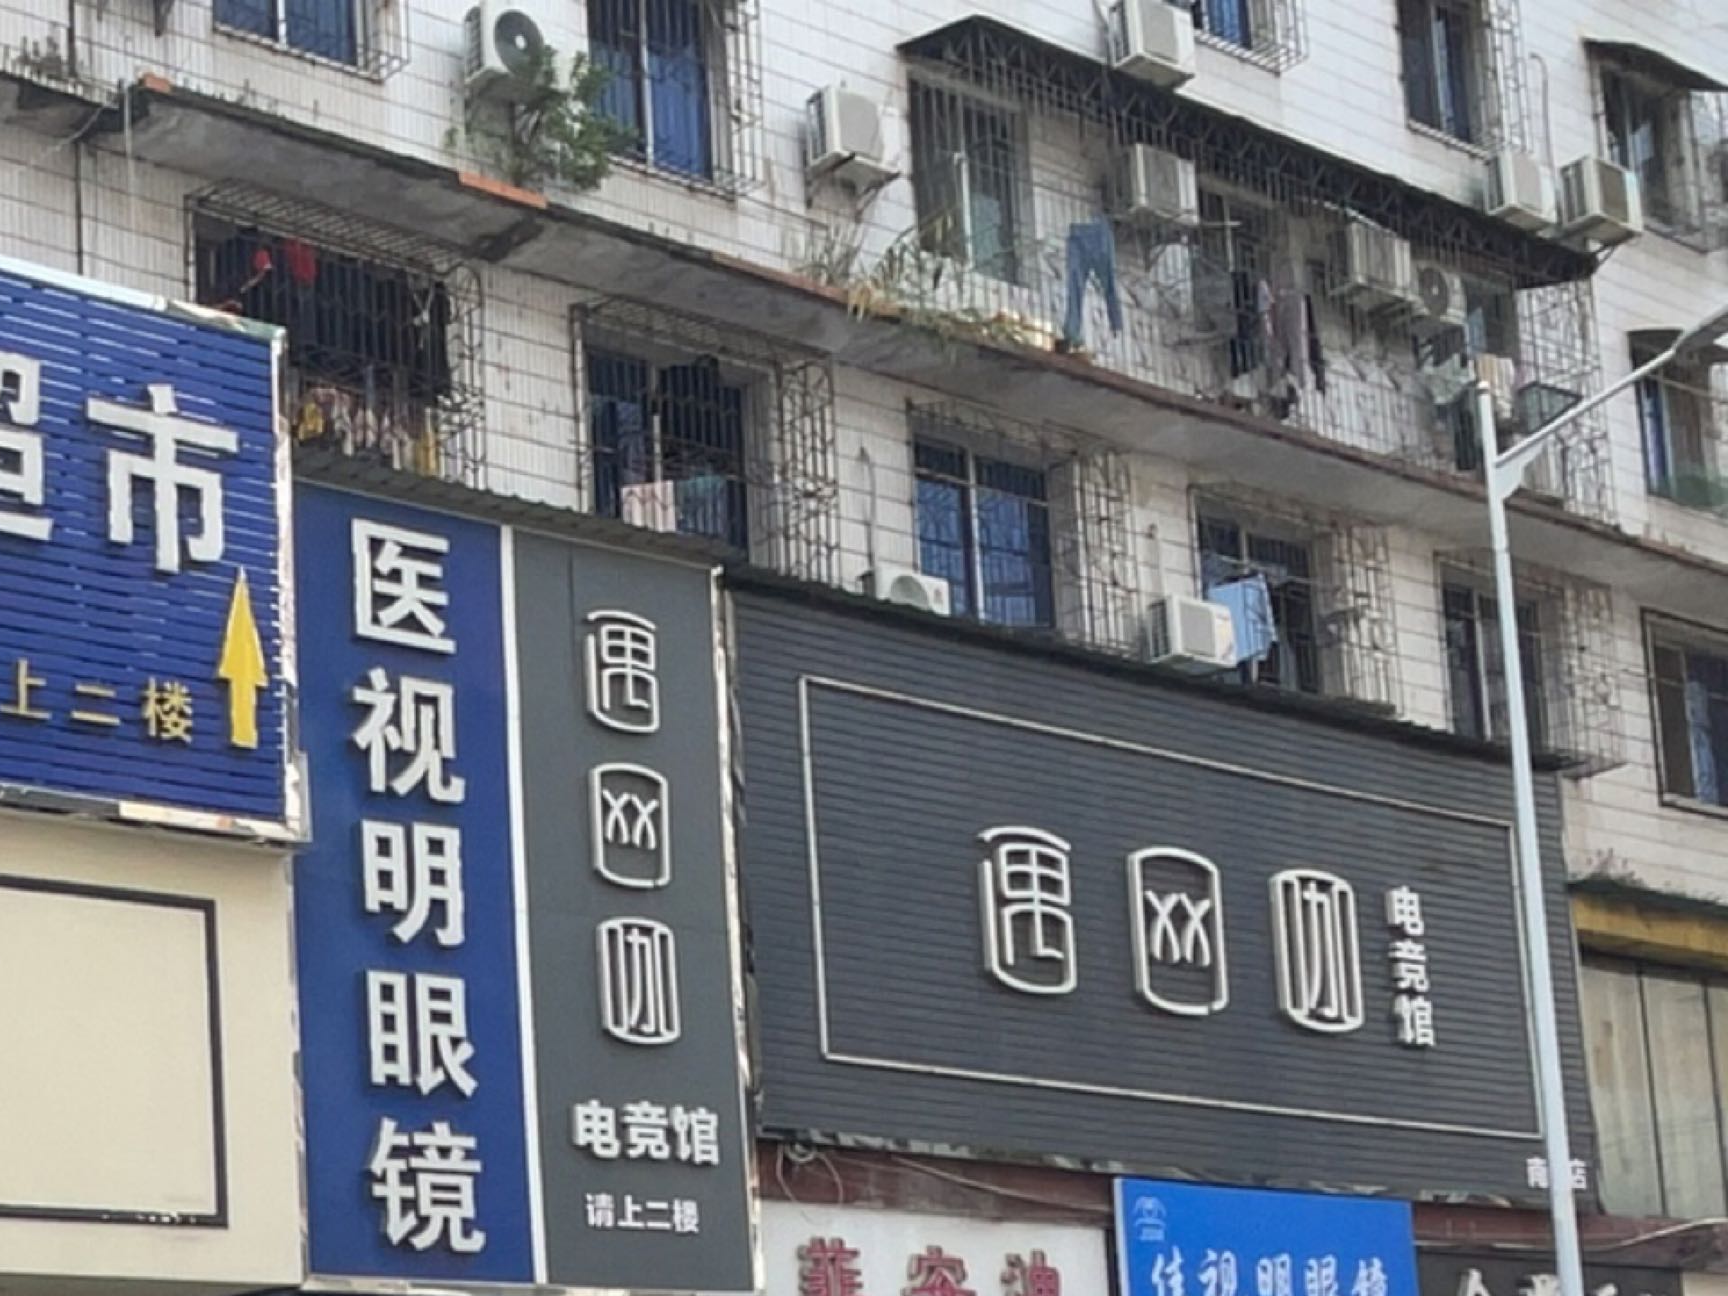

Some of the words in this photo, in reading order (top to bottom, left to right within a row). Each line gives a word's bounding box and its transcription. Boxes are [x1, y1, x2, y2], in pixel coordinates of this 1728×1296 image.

[350, 517, 487, 1256] 医视明眼镜
[573, 1099, 721, 1165] 电竞馆
[584, 1192, 700, 1234] 请上二楼
